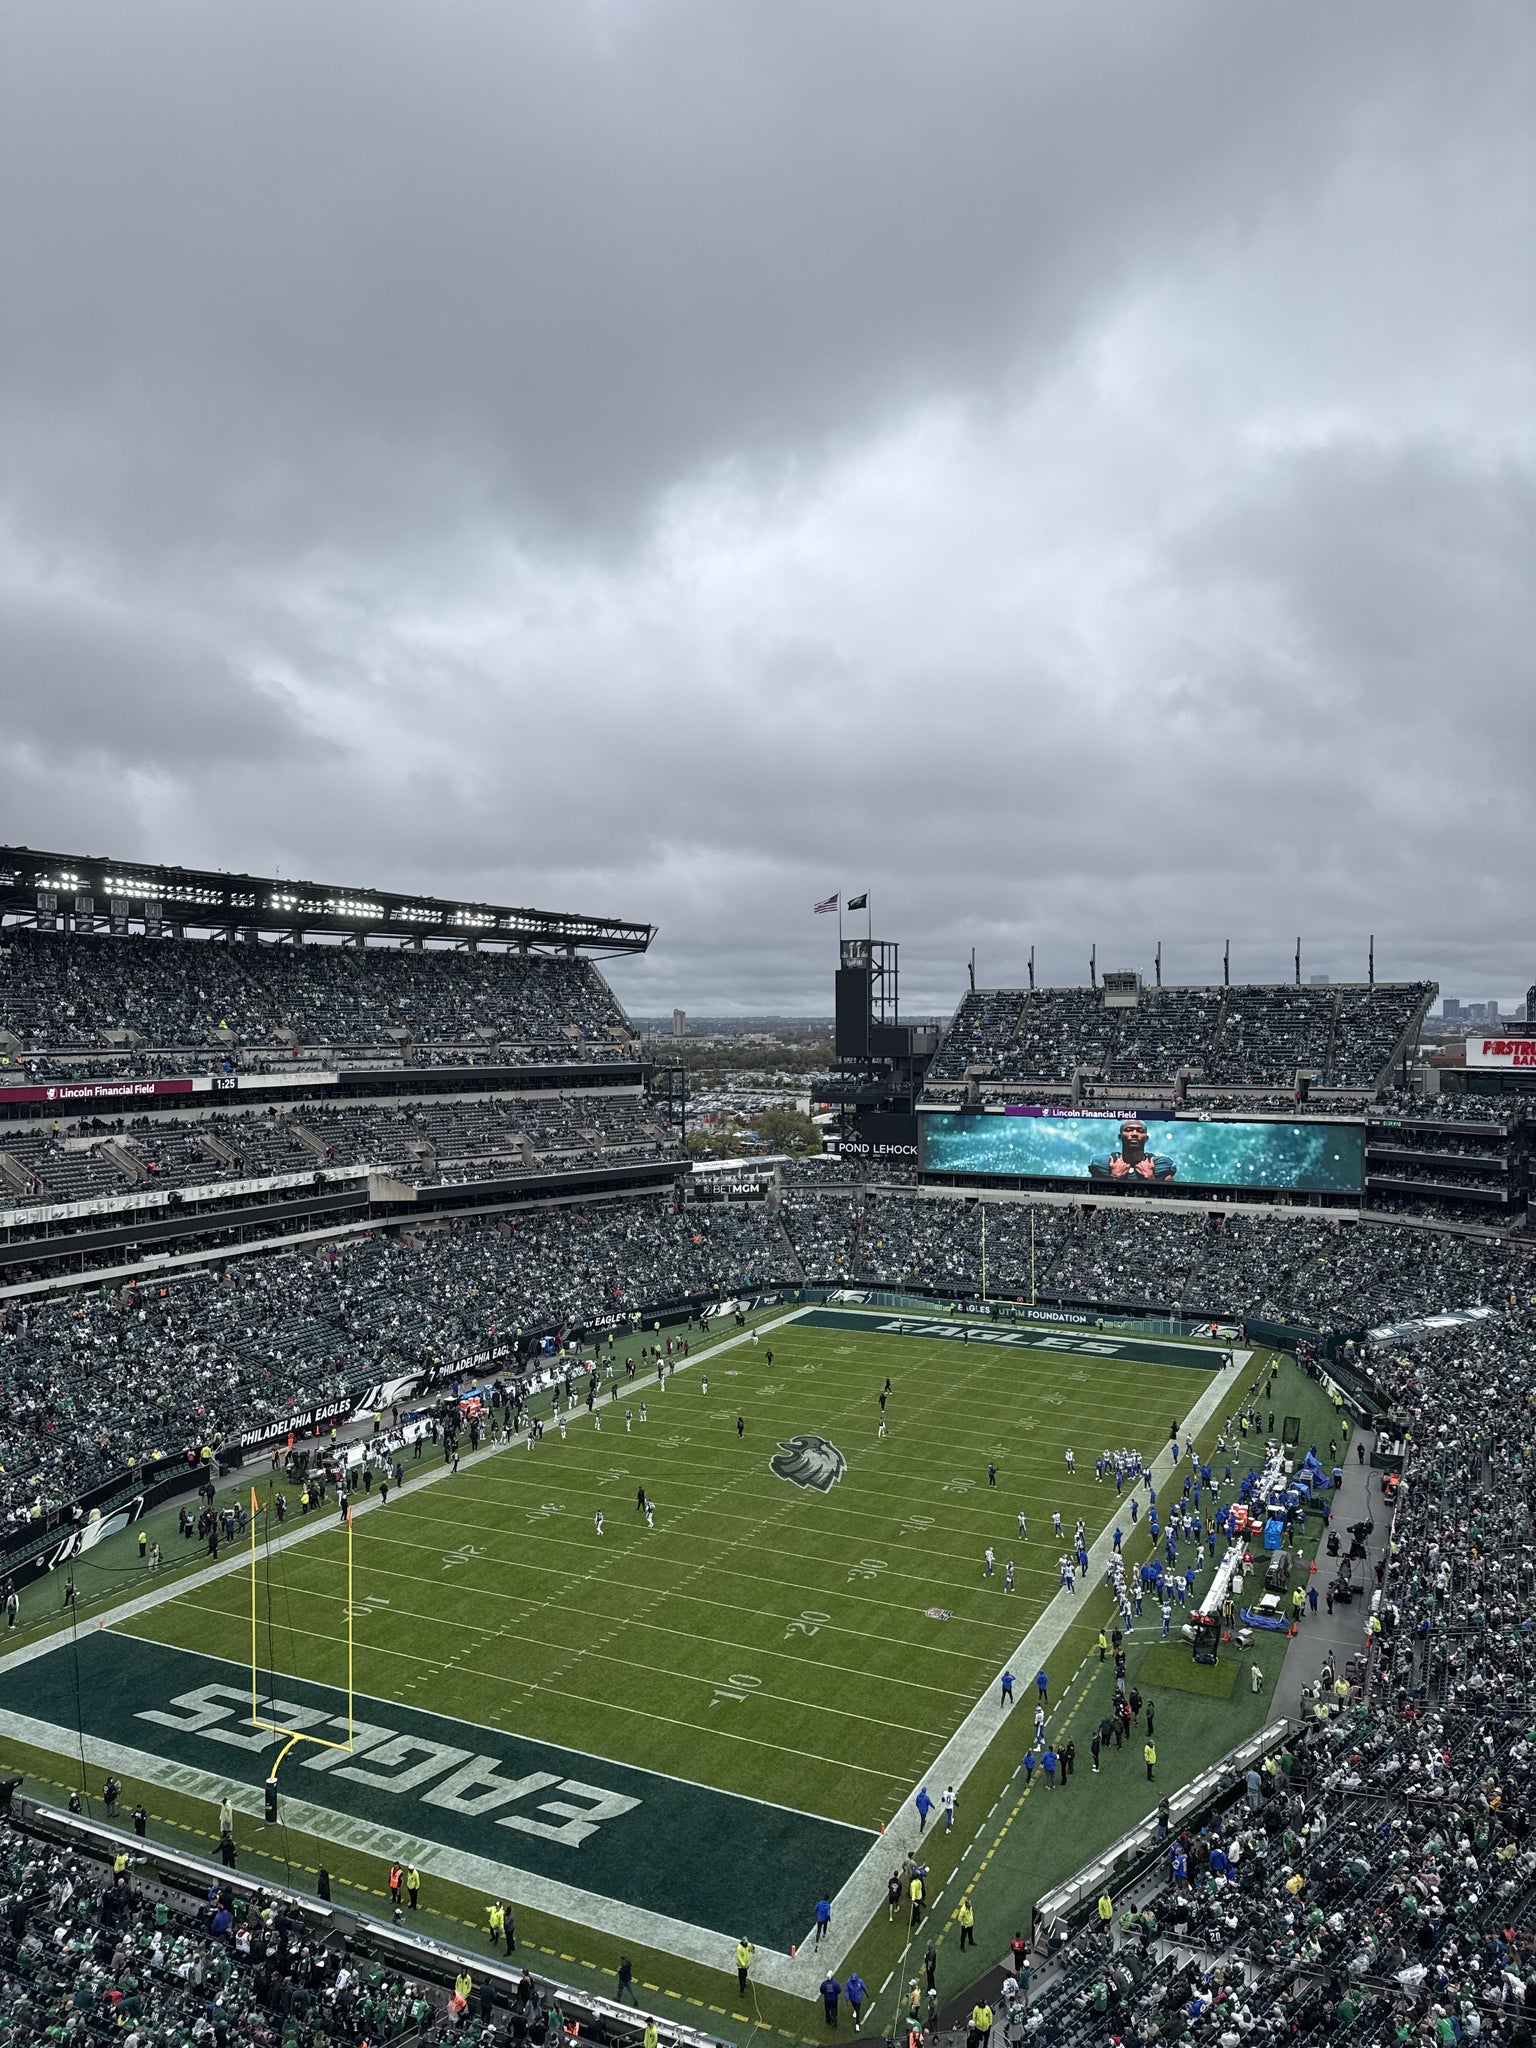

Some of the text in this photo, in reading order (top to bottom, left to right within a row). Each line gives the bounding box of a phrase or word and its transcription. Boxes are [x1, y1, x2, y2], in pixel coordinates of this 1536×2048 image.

[60, 1084, 154, 1098] Lincoln Financial Field
[216, 1079, 235, 1089] 1:25
[1052, 1109, 1137, 1119] Lincoln Financial Field
[839, 1144, 870, 1153] POND
[713, 1184, 760, 1194] BETMGM
[595, 1312, 626, 1326] EAGLES
[1028, 1310, 1087, 1323] FOUNDATION
[876, 1320, 1126, 1354] EAGLES
[439, 1341, 518, 1376] PHILADELPHIA EAGLS
[240, 1399, 351, 1448] PHILADELPHIA EAGLES
[525, 1502, 566, 1520] 30
[902, 1514, 936, 1533] 40
[442, 1544, 488, 1564] 20
[848, 1558, 888, 1580] 30
[342, 1594, 391, 1617] 10
[786, 1610, 831, 1636] 20
[714, 1674, 762, 1703] 10
[132, 1682, 643, 1848] EAGLES
[288, 1806, 442, 1866] INSPIRE
[24, 1888, 32, 1896] 27
[1210, 1932, 1220, 1942] 20
